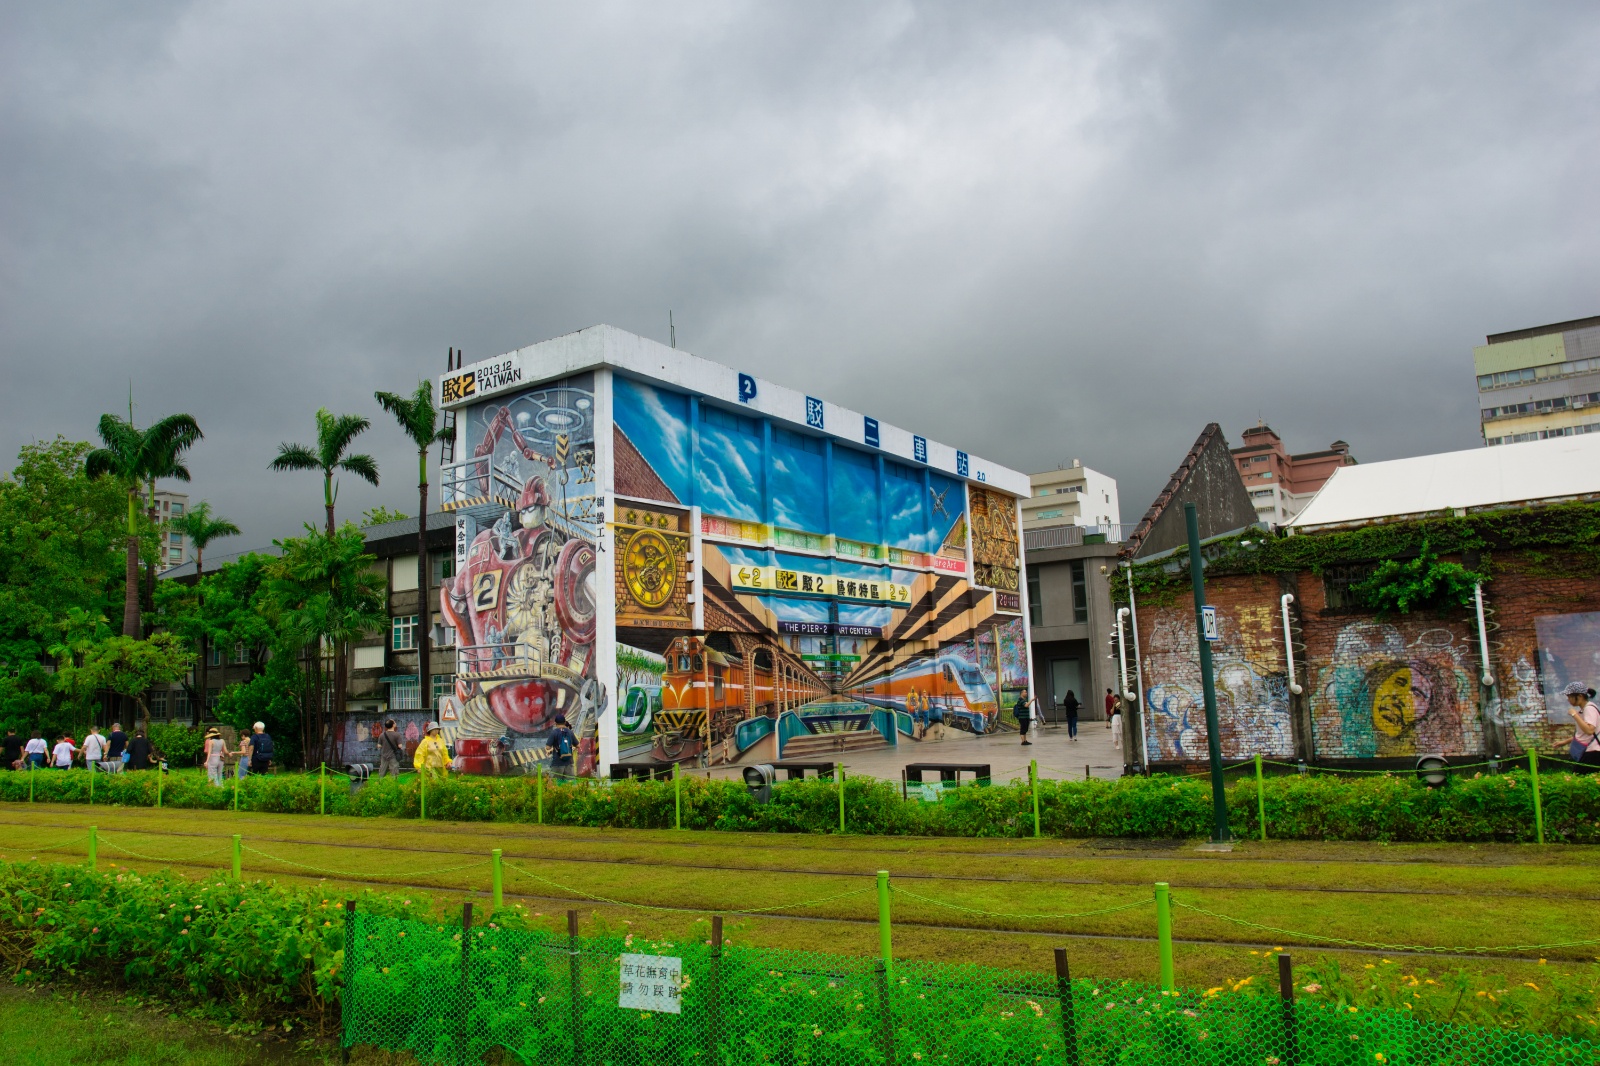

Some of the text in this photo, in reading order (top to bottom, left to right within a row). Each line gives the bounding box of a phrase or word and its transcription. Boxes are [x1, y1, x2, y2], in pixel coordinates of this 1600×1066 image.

[477, 360, 512, 379] 2013.12
[442, 371, 475, 404] 駁2
[477, 368, 521, 391] TAIWAN
[977, 471, 986, 482] 2.0
[457, 519, 466, 563] 安全第一
[581, 553, 589, 562] 2
[867, 547, 875, 557] to
[477, 574, 495, 605] 2
[751, 569, 761, 587] 2
[889, 584, 896, 600] 2
[784, 623, 798, 632] THE
[802, 624, 828, 634] PIER-2
[849, 627, 872, 635] CENTER
[622, 982, 679, 999] 請勿踩踏
